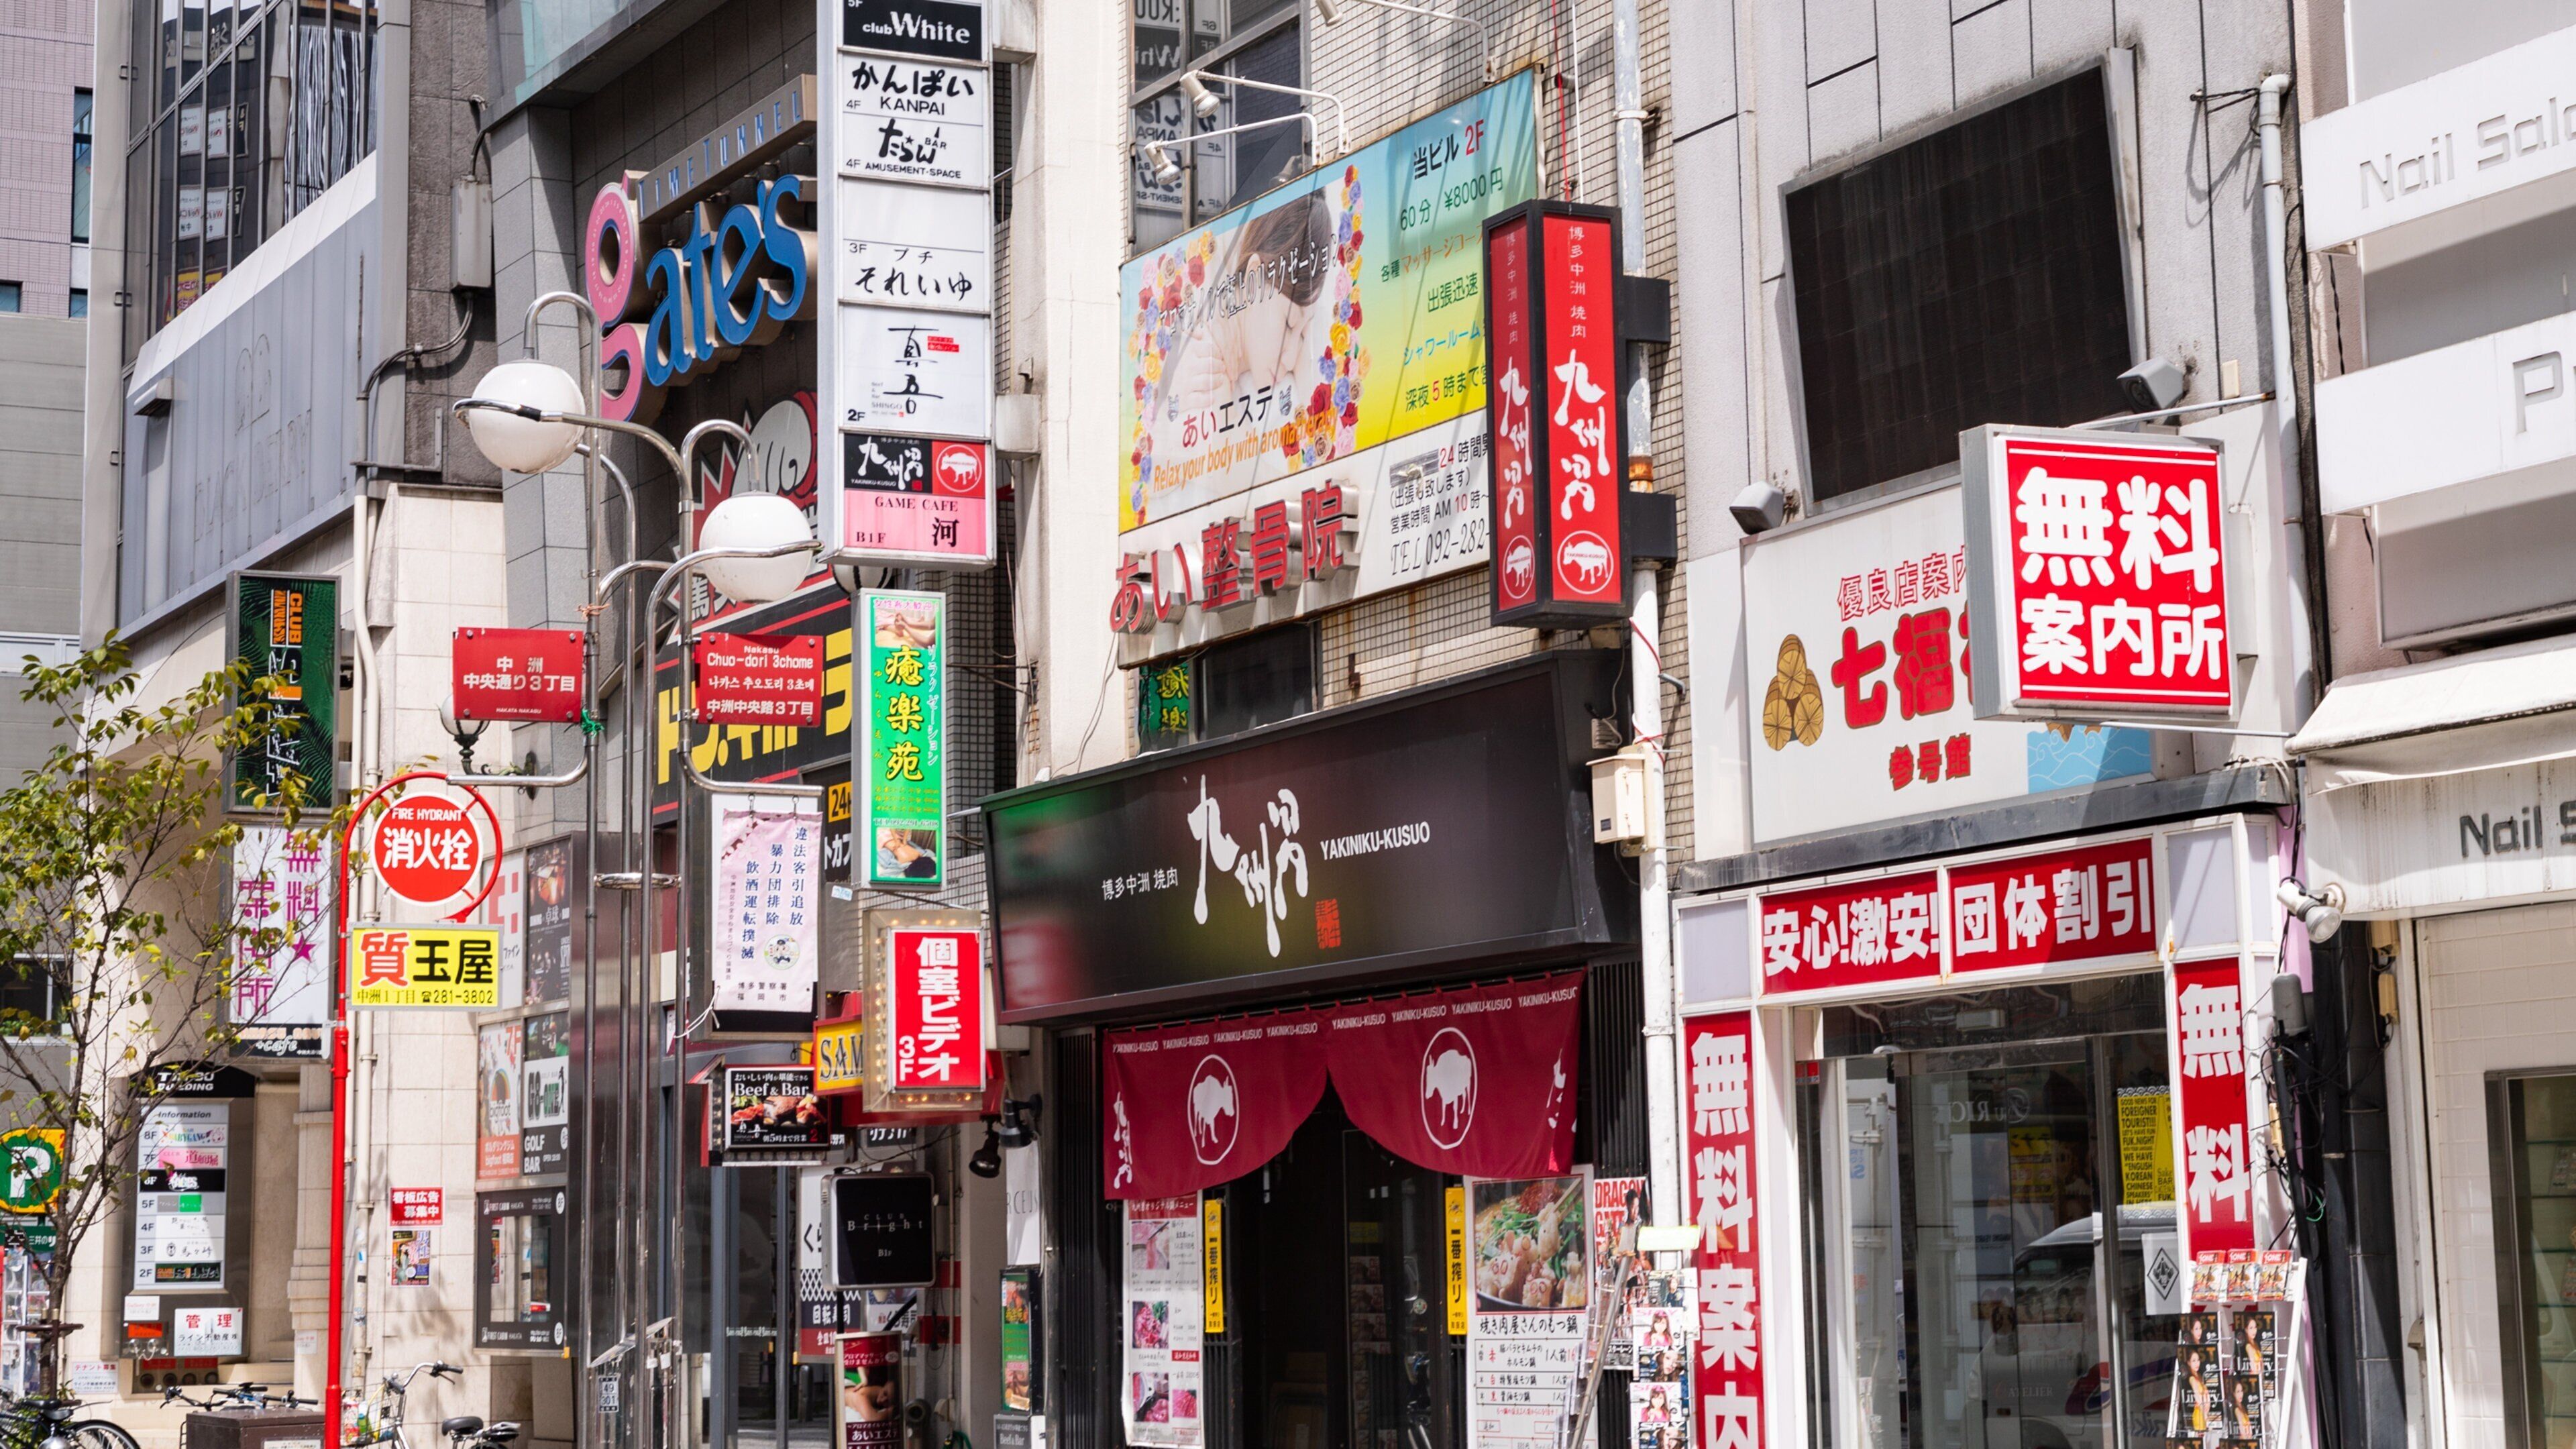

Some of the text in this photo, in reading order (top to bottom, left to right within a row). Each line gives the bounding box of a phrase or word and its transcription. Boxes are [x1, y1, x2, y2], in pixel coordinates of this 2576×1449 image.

[863, 11, 971, 44] club White
[852, 61, 975, 97] かんぱい
[846, 99, 861, 109] 4F
[880, 96, 945, 115] KANPAI
[638, 91, 801, 220] TIME TUNNEL
[924, 137, 947, 150] BAR
[1414, 119, 1485, 180] 当ビル 2F
[846, 159, 861, 169] 4F
[2360, 133, 2455, 209] Nail
[1401, 167, 1503, 231] 60分 ¥8000円
[849, 243, 867, 254] 3F
[894, 248, 933, 264] プチ
[855, 267, 973, 301] それいゆ
[1428, 272, 1479, 313] 出張迅速
[1568, 226, 1587, 338] 博多中洲 焼肉
[1404, 321, 1481, 366] シャワールーム
[847, 409, 866, 422] 2F
[1183, 385, 1273, 447] あいエステ
[1154, 409, 1338, 492] Relax your body with aromatherapy
[851, 478, 897, 487] YAKINIKU-KUSUO
[875, 496, 959, 513] GAME CAFE
[856, 531, 886, 543] B1F
[932, 517, 961, 547] 河
[2016, 468, 2220, 593] 無料
[1109, 478, 1344, 633] あい整骨院
[1391, 537, 1421, 576] TEL
[289, 593, 303, 644] CLUB
[744, 645, 780, 653] Nakasu
[2021, 593, 2224, 680] 案内所
[496, 657, 543, 673] 中洲
[707, 653, 814, 668] Chuo-dori 3chome
[1831, 602, 1972, 729] 七福
[463, 673, 576, 692] 中央通り3丁目
[708, 676, 740, 690] 나카스
[743, 677, 784, 690] 추오도리
[707, 699, 814, 715] 中洲中央路3丁目
[885, 645, 924, 781] 癒楽苑
[926, 645, 940, 767] リラクゼーション
[1888, 733, 1972, 791] 参号館
[392, 808, 463, 821] FIRE HYDRANT
[1320, 821, 1430, 861] YAKINIKU-KUSUO
[2460, 806, 2543, 858] Nail
[382, 826, 473, 871] 消火栓
[766, 843, 784, 925] 暴力団排除
[1102, 867, 1179, 902] 博多中洲 焼肉
[741, 861, 759, 960] 飲酒運転撲滅
[1955, 857, 2153, 957] 団体割引
[360, 931, 494, 987] 質 玉屋
[357, 989, 494, 1004] 中洲1丁目 281-3802
[737, 994, 787, 1002] 福岡市
[738, 981, 787, 991] 博多警察署
[916, 937, 962, 1081] 個室ビデオ
[1267, 1022, 1318, 1038] YAKINIKU-KUSUO
[1332, 1012, 1386, 1030] YAKINIKU-KUSUO
[1391, 1005, 1447, 1023] YAKINIKU-KUSUO
[1451, 997, 1513, 1015] YAKINIKU-KUSUO
[898, 1035, 916, 1081] 3F
[735, 1082, 809, 1096] Beef & Bar
[2178, 983, 2251, 1224] 無料
[2122, 1106, 2157, 1116] FOREIGNER
[525, 1134, 545, 1153] GOLF
[2124, 1152, 2153, 1161] WE HAVE
[524, 1157, 541, 1173] BAR
[2125, 1172, 2153, 1181] KOREAN
[392, 1191, 439, 1203] 看板広告
[2126, 1182, 2153, 1190] CHINESE
[142, 1200, 155, 1208] 5F
[404, 1205, 439, 1218] 募集中
[140, 1246, 154, 1254] 3F
[1691, 1031, 1759, 1449] 無料案内
[140, 1269, 153, 1277] 2F
[185, 1314, 233, 1330] 管理
[1480, 1315, 1578, 1335] 焼き肉屋さんのもつ鍋
